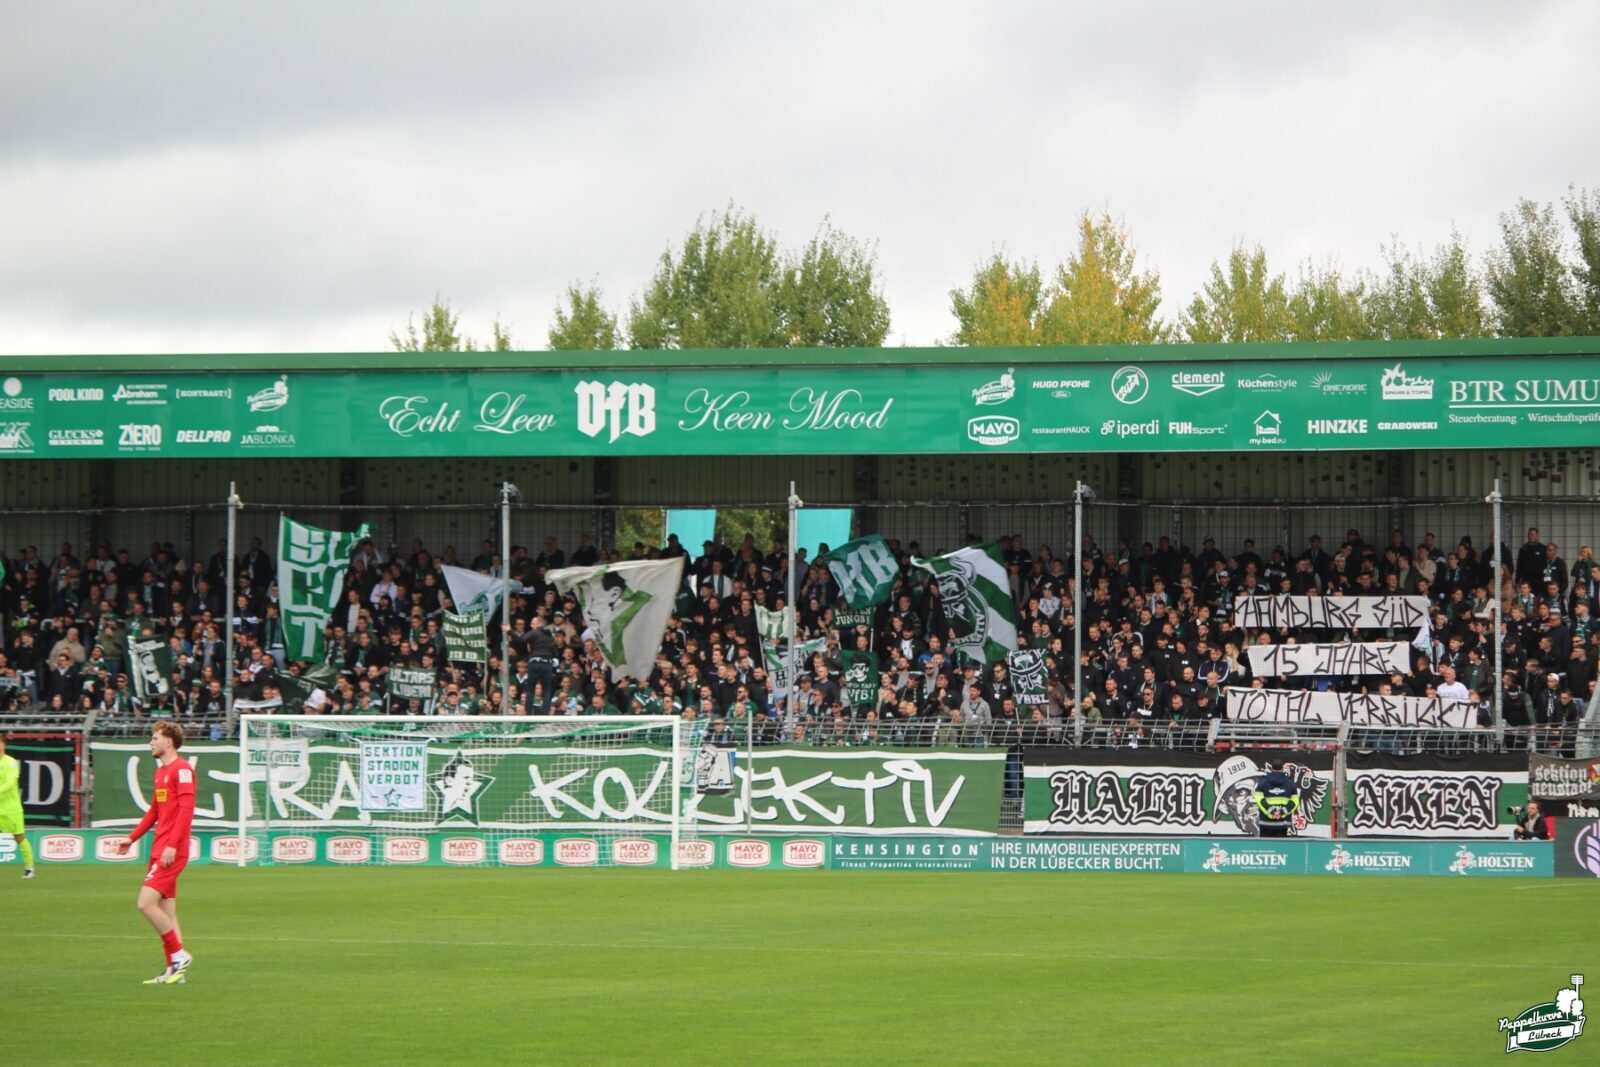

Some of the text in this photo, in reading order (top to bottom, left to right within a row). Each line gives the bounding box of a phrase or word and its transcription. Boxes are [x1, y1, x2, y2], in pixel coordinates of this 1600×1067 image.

[1032, 380, 1090, 388] HUGO PFOHE
[1172, 372, 1225, 384] clement
[1450, 380, 1507, 402] BTR
[379, 391, 556, 437] Echt Leev
[574, 380, 656, 444] VfB
[678, 387, 893, 431] Keen Mood
[1449, 414, 1517, 424] Steuerberatung
[973, 422, 1014, 434] MAYO
[1116, 420, 1160, 438] iperdi
[1308, 420, 1368, 434] HINZKE
[1378, 422, 1438, 430] GRABOWSKI
[176, 430, 231, 443] DELLPRO
[240, 434, 296, 444] JABLONKA
[1236, 597, 1424, 628] HAMBURG SÜD
[1264, 644, 1397, 675] 15 JAHRE
[1230, 690, 1479, 728] TOTAL VERRÜCKT
[364, 746, 423, 757] SEKTION
[368, 760, 420, 771] STADION
[368, 774, 420, 785] VERBOT
[836, 844, 978, 856] KENSINGTON
[992, 843, 1180, 856] IHRE IMMOBILIENEXPERTEN
[992, 854, 1163, 870] IN DER LÜBECKER BUCHT.
[1231, 854, 1286, 865] HOLSTEN
[1354, 855, 1410, 867] HOLSTEN
[1478, 856, 1534, 868] HOLSTEN
